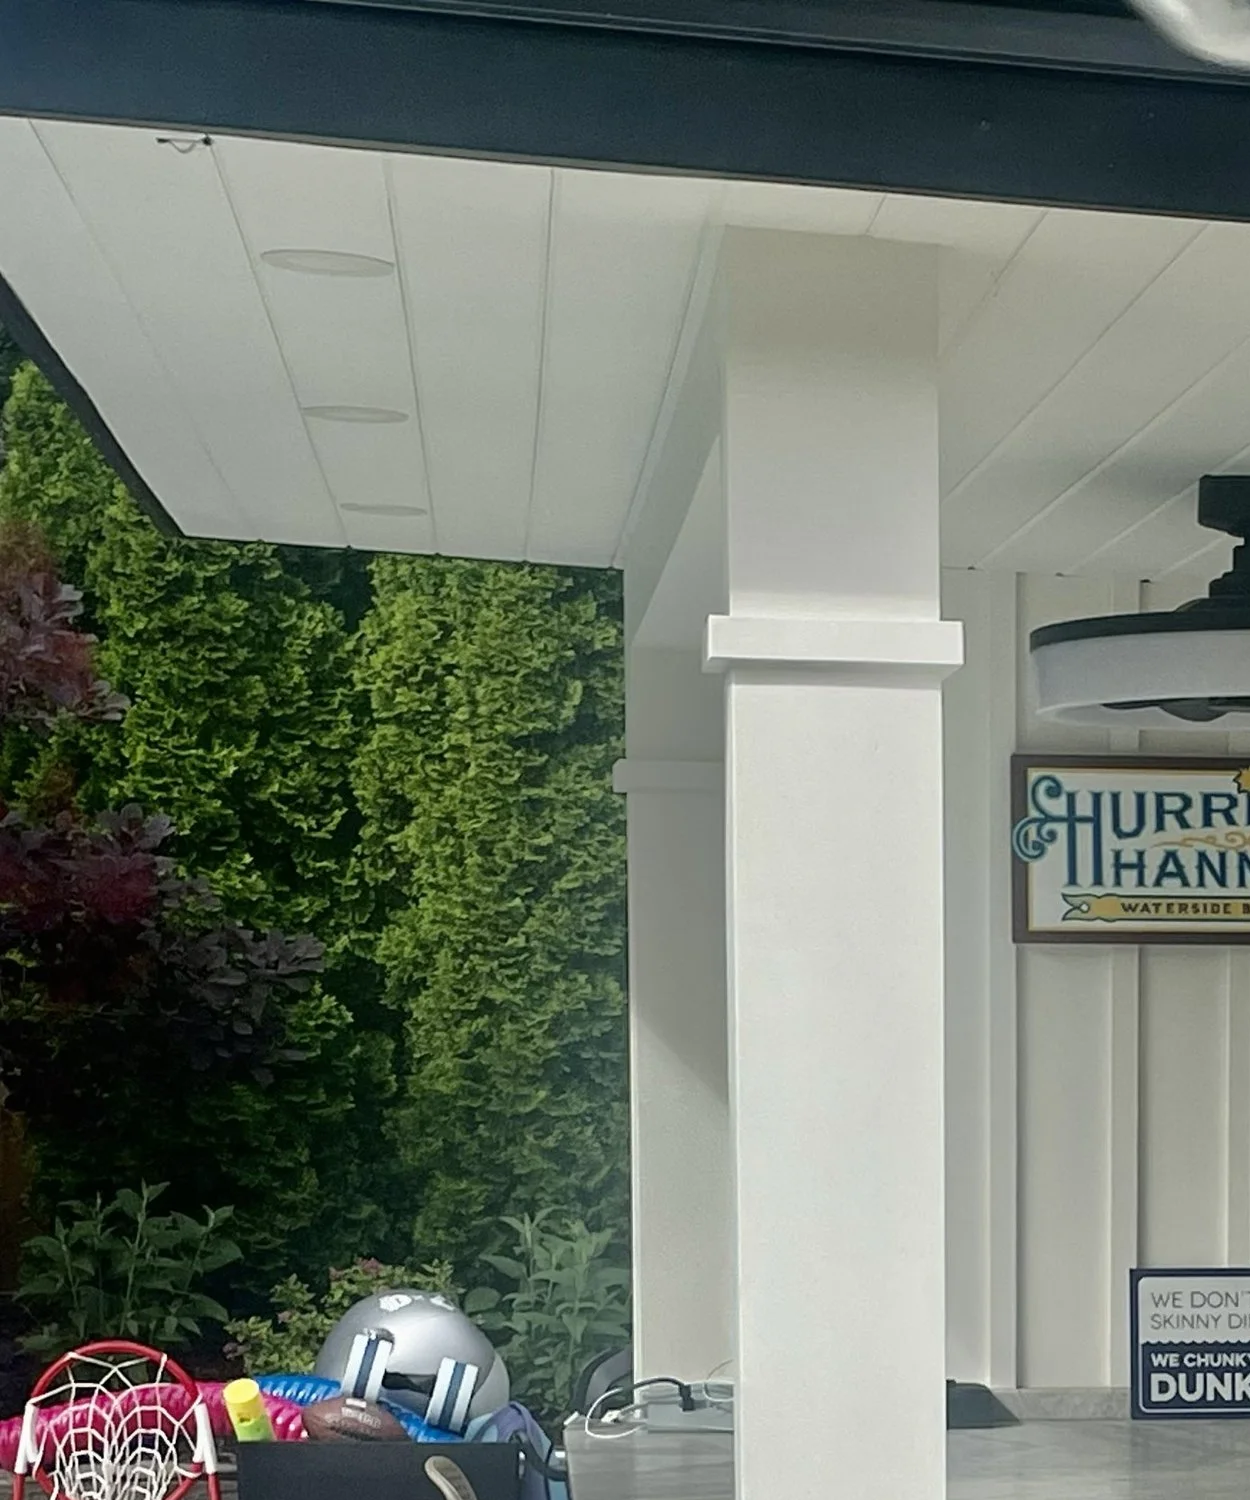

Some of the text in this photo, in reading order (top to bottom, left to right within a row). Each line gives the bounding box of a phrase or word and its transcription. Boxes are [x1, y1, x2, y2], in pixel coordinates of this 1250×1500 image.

[1120, 902, 1232, 915] WATERSIDE
[1150, 1291, 1183, 1309] WE
[1150, 1313, 1222, 1330] SKINNY
[1151, 1353, 1180, 1368] WE
